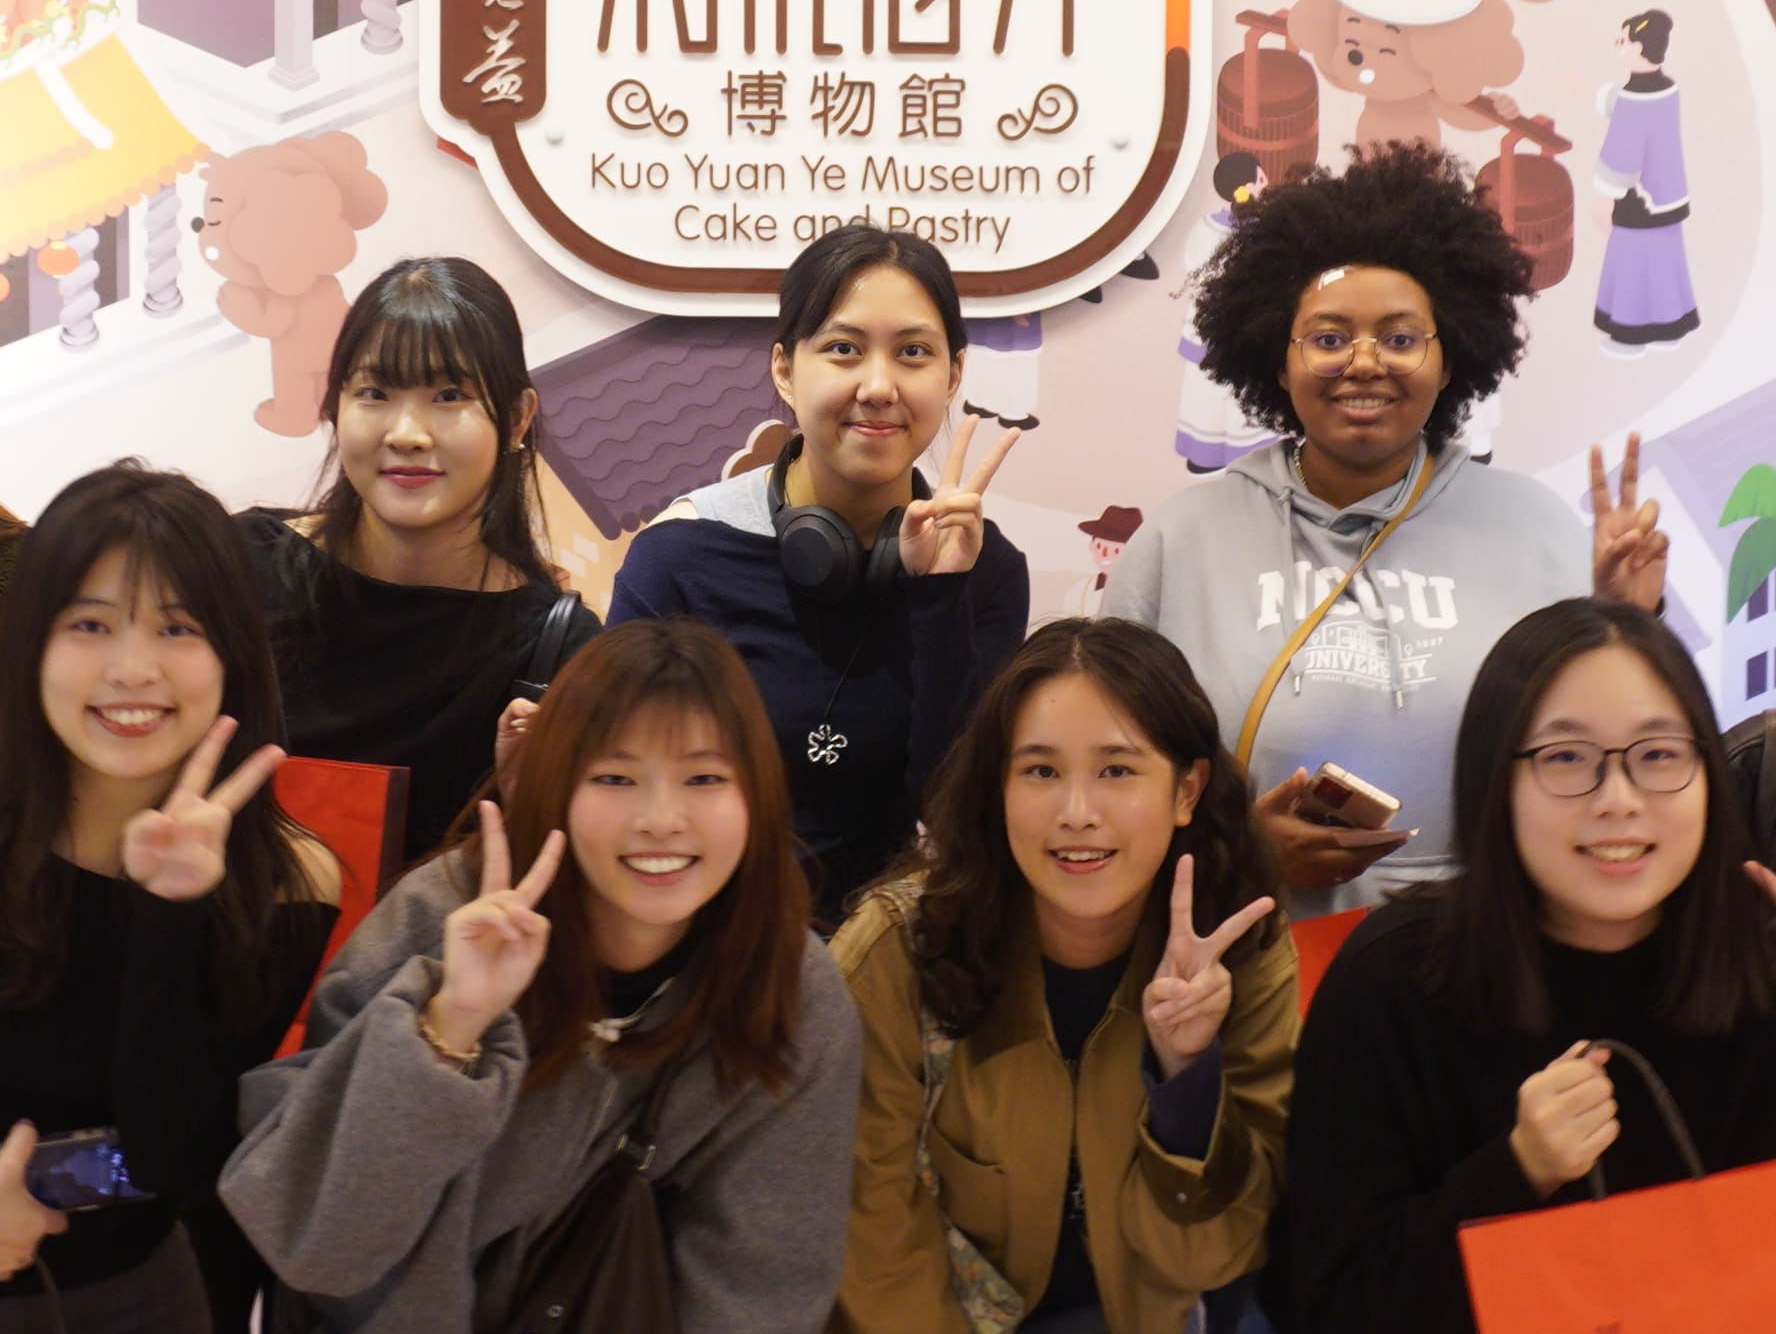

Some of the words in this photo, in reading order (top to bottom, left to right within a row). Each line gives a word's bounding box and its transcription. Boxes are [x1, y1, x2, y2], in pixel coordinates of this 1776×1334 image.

[720, 70, 967, 139] 博物館
[590, 153, 669, 191] Kuo
[684, 153, 786, 192] Yuan
[801, 154, 847, 192] Ye
[861, 155, 1041, 194] Museum
[1057, 154, 1096, 193] of
[674, 202, 778, 243] Cake
[792, 203, 871, 243] and
[887, 204, 1012, 254] Pastry
[1257, 561, 1459, 632] NCCU
[1305, 649, 1430, 681] UNIVERSTY
